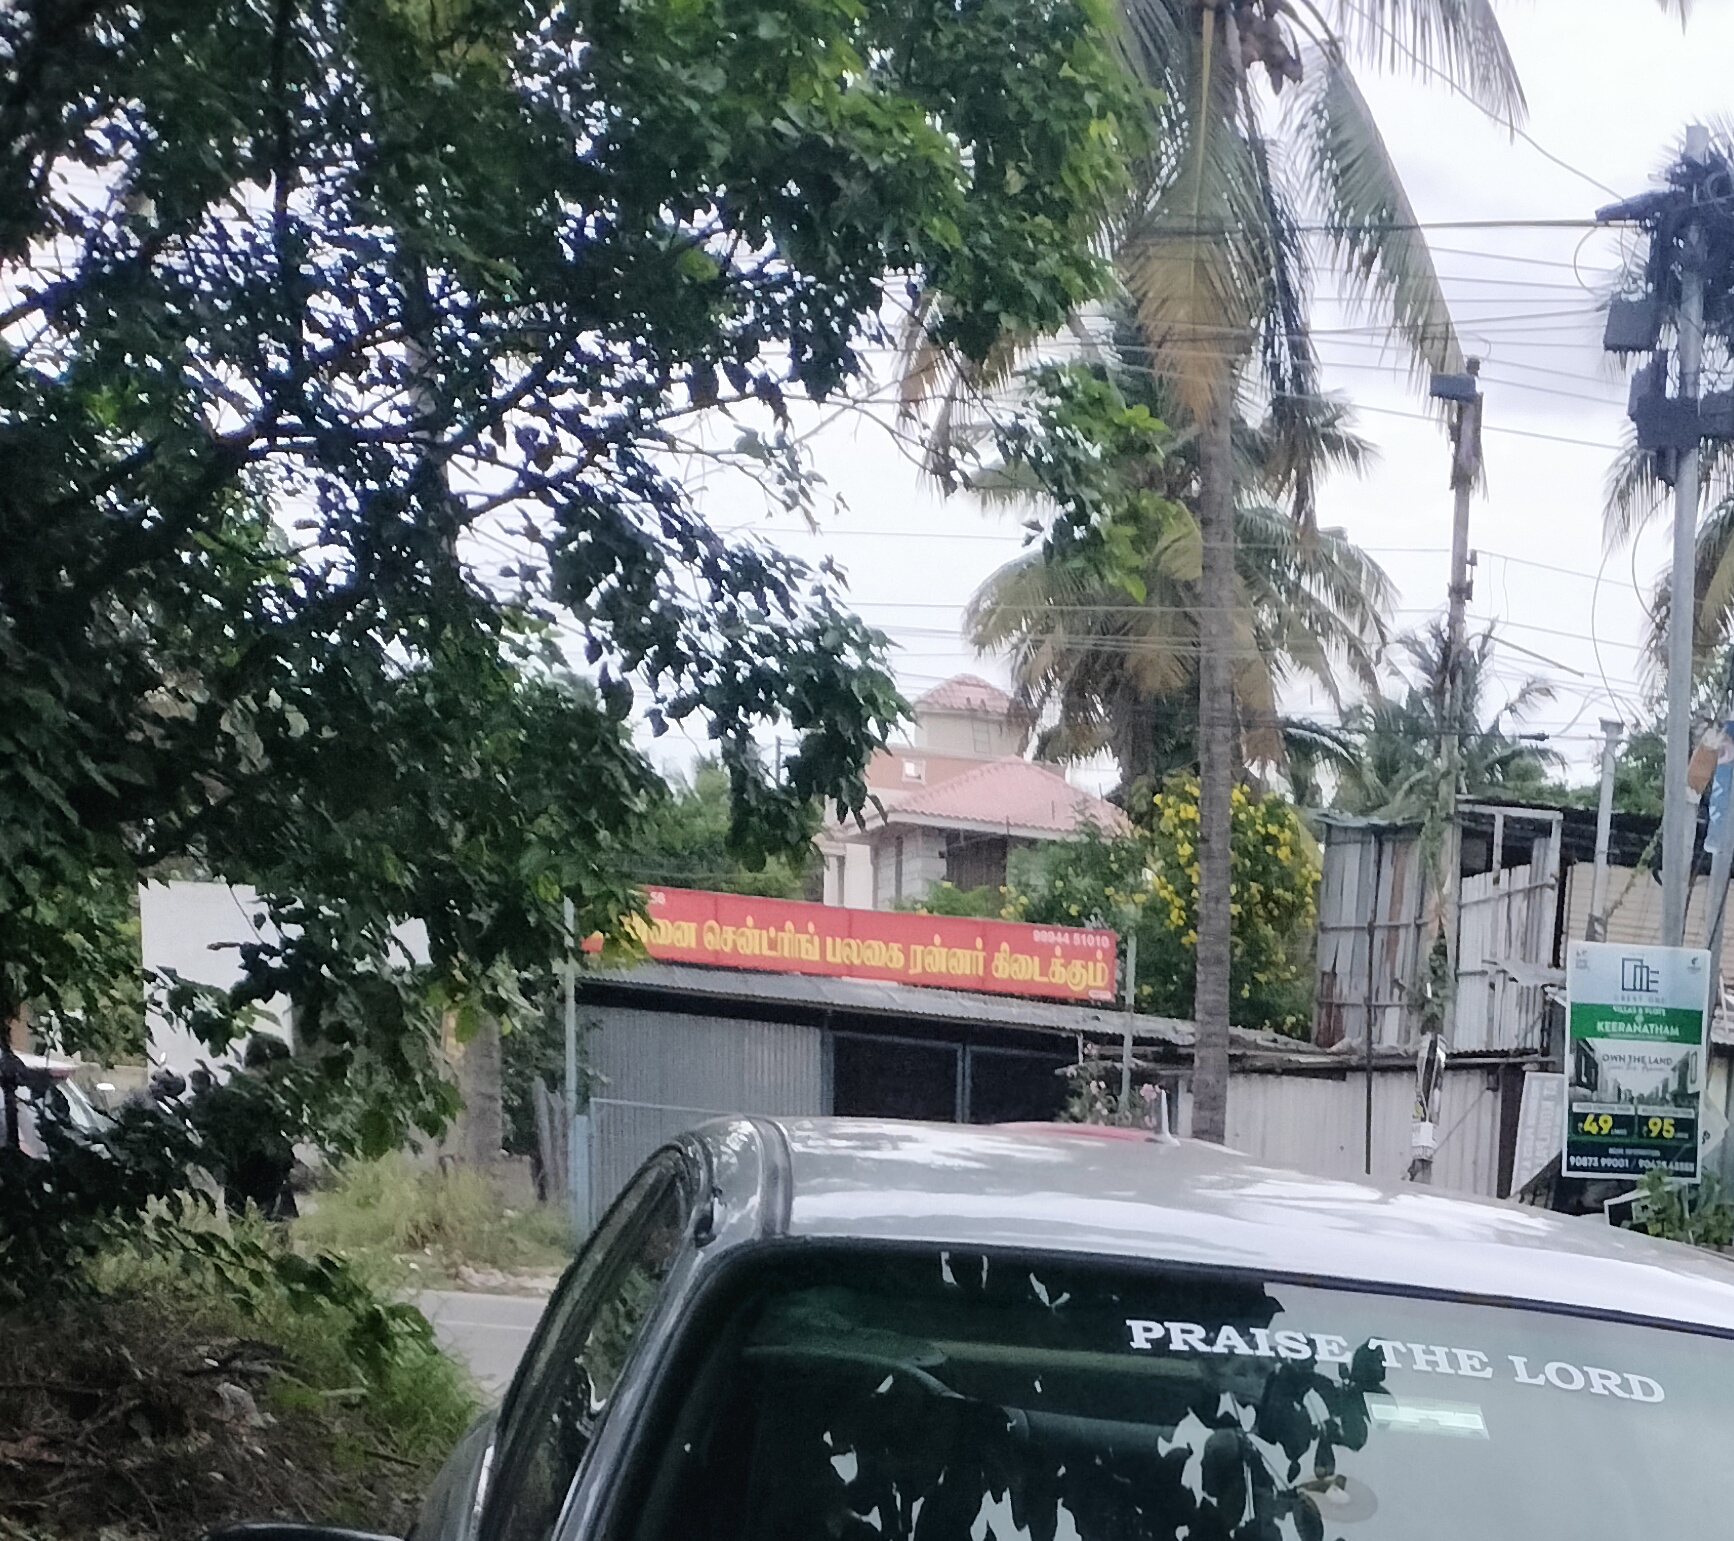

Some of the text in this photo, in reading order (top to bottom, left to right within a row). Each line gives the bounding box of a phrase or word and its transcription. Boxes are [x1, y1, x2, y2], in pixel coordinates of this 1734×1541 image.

[825, 934, 904, 970] பலகை
[991, 940, 1110, 992] கிடைக்கும்
[1596, 1021, 1680, 1037] KEERANATHAM
[1124, 1319, 1665, 1403] PRAISE THE LORD
